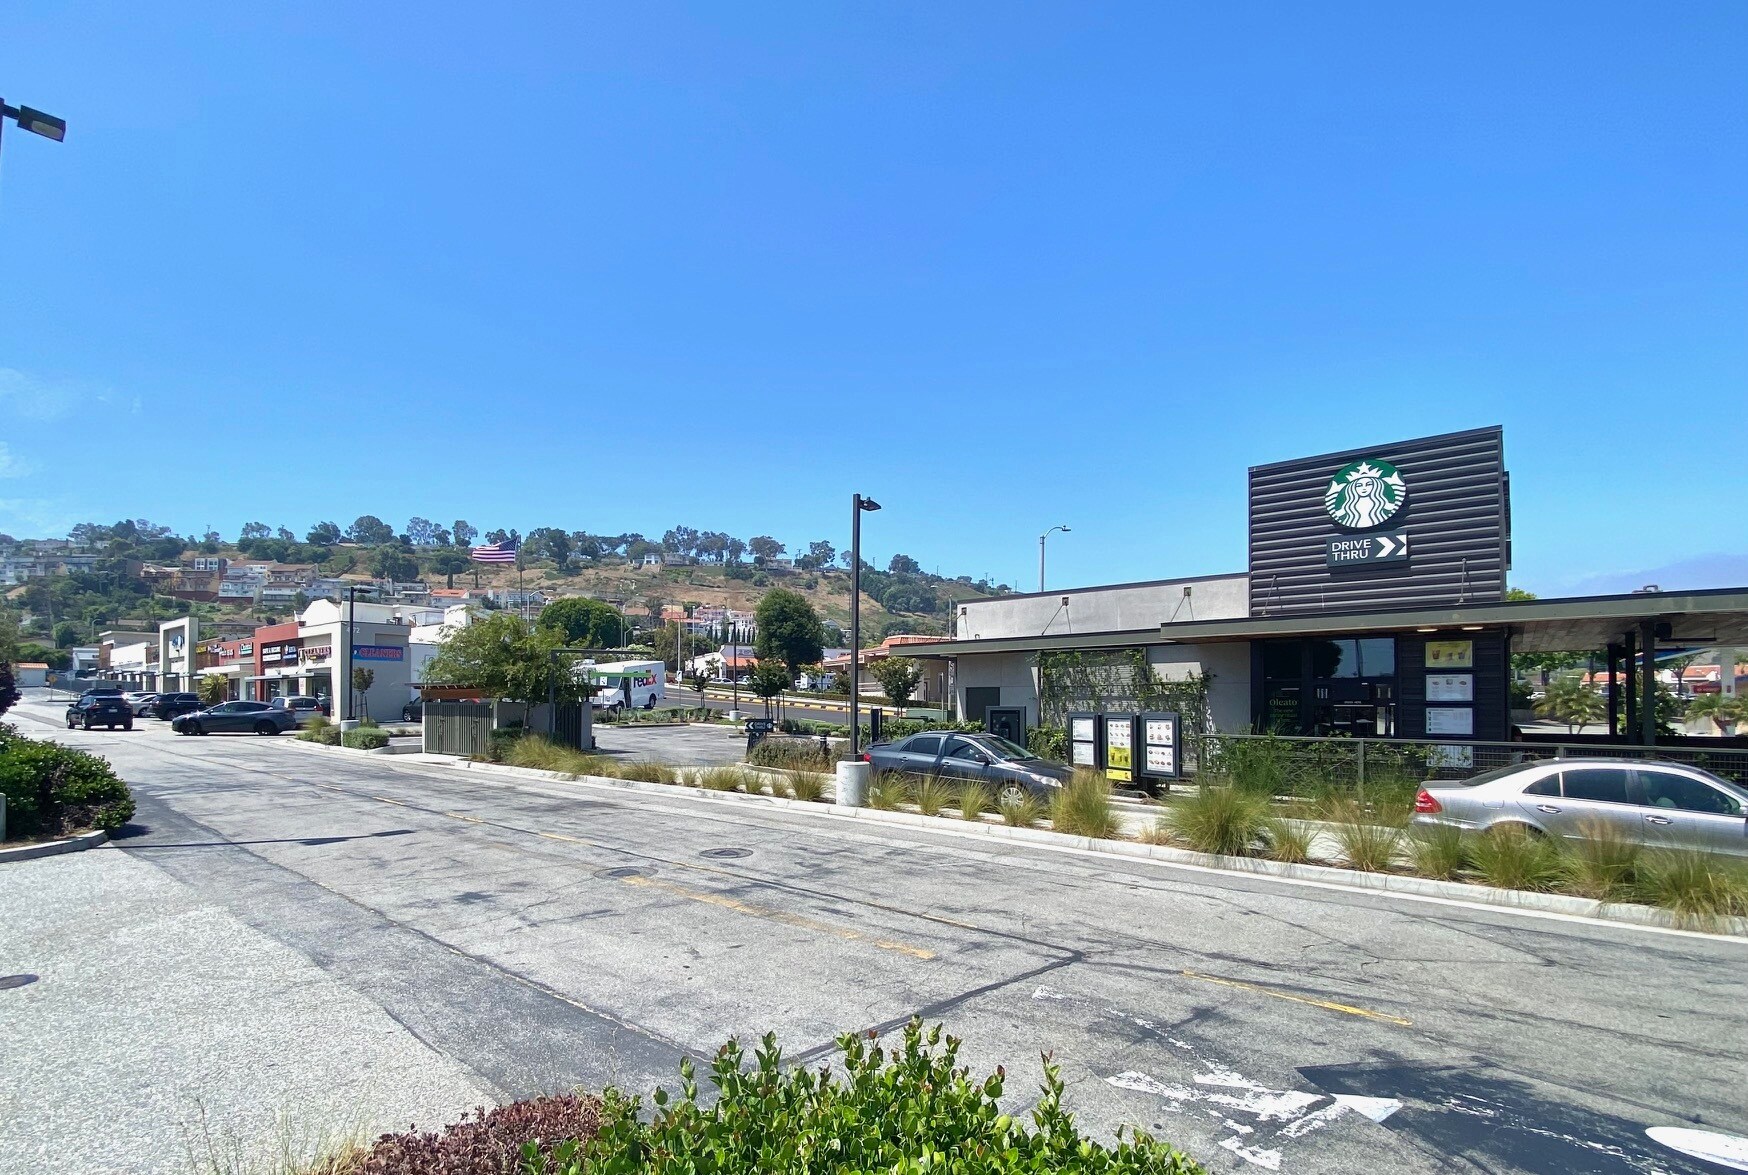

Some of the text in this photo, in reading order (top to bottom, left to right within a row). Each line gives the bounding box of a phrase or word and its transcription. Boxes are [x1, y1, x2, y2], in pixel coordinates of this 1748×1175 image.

[1331, 539, 1372, 552] DRIVE
[1331, 549, 1369, 561] THRU
[1269, 698, 1298, 706] Oleato
